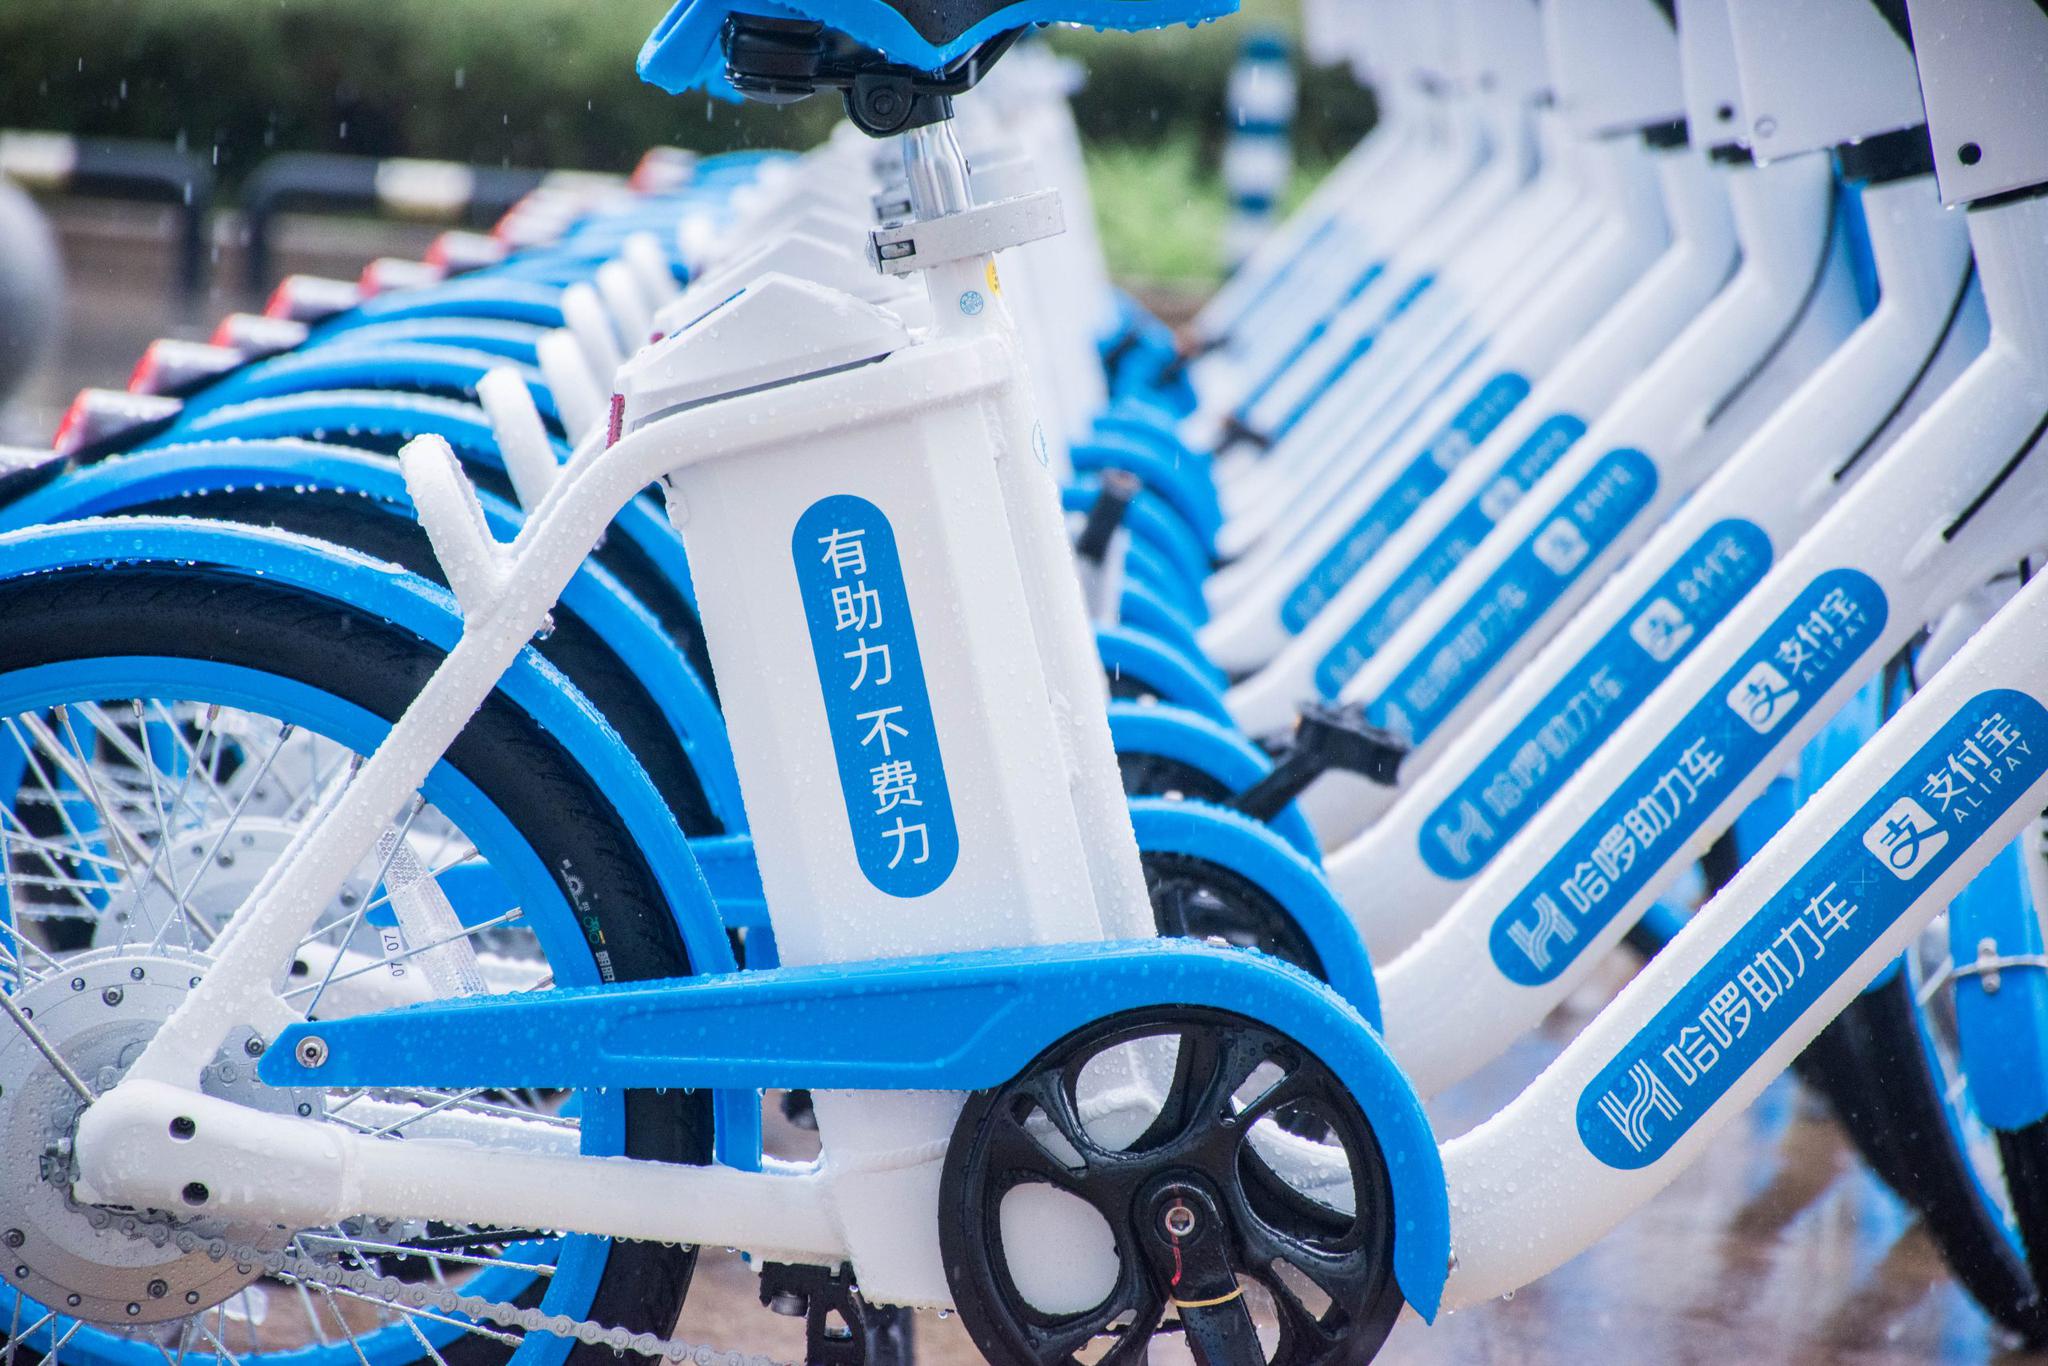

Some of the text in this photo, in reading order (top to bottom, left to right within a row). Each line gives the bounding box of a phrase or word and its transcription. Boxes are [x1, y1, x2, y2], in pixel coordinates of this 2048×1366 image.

[1775, 587, 1858, 674] 支付宝
[1802, 612, 1868, 684] ALIPAY
[818, 528, 930, 870] 有助力不费力
[1921, 713, 2021, 812] 支付宝
[1953, 742, 2032, 823] ALIPAY
[1561, 736, 1724, 914] 哈啰助力车
[1662, 882, 1859, 1086] 哈啰助力车
